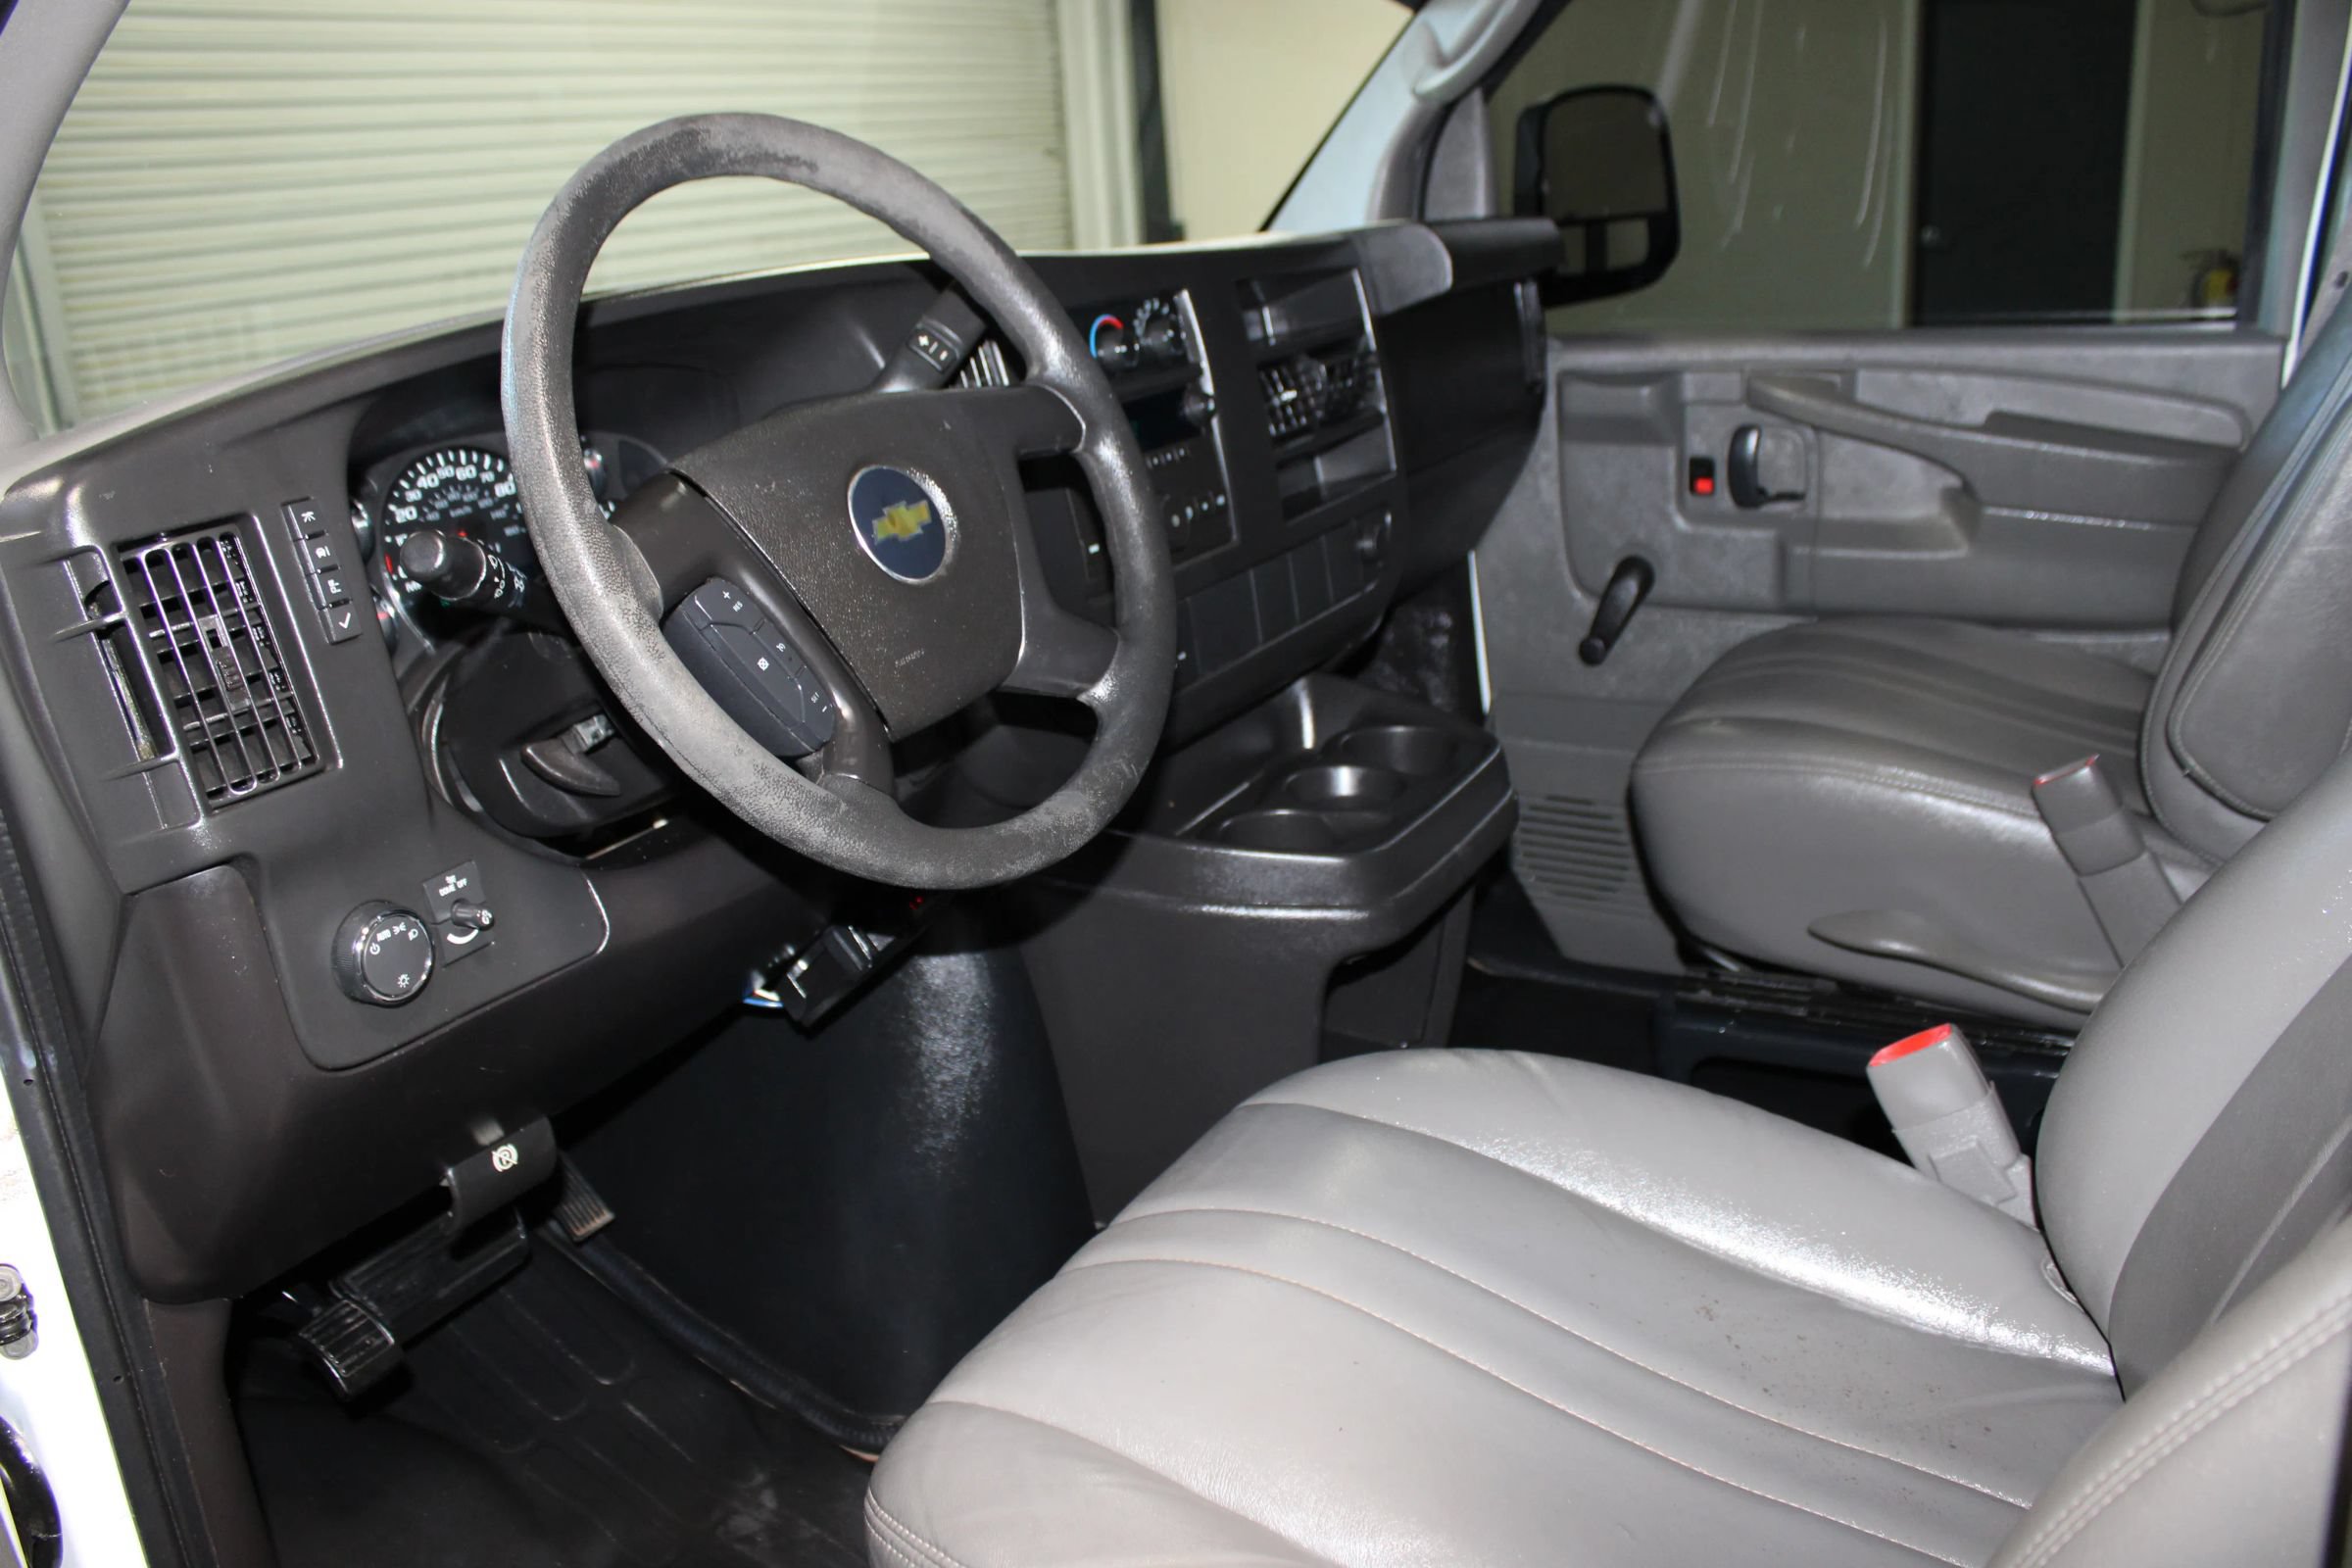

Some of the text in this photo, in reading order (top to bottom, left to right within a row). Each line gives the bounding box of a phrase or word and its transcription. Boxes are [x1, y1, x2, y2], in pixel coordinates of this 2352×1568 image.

[436, 465, 455, 479] 50
[456, 465, 477, 481] 60
[479, 470, 495, 483] 70
[416, 473, 440, 489] 40
[494, 480, 516, 498] 80
[394, 506, 417, 523] 20
